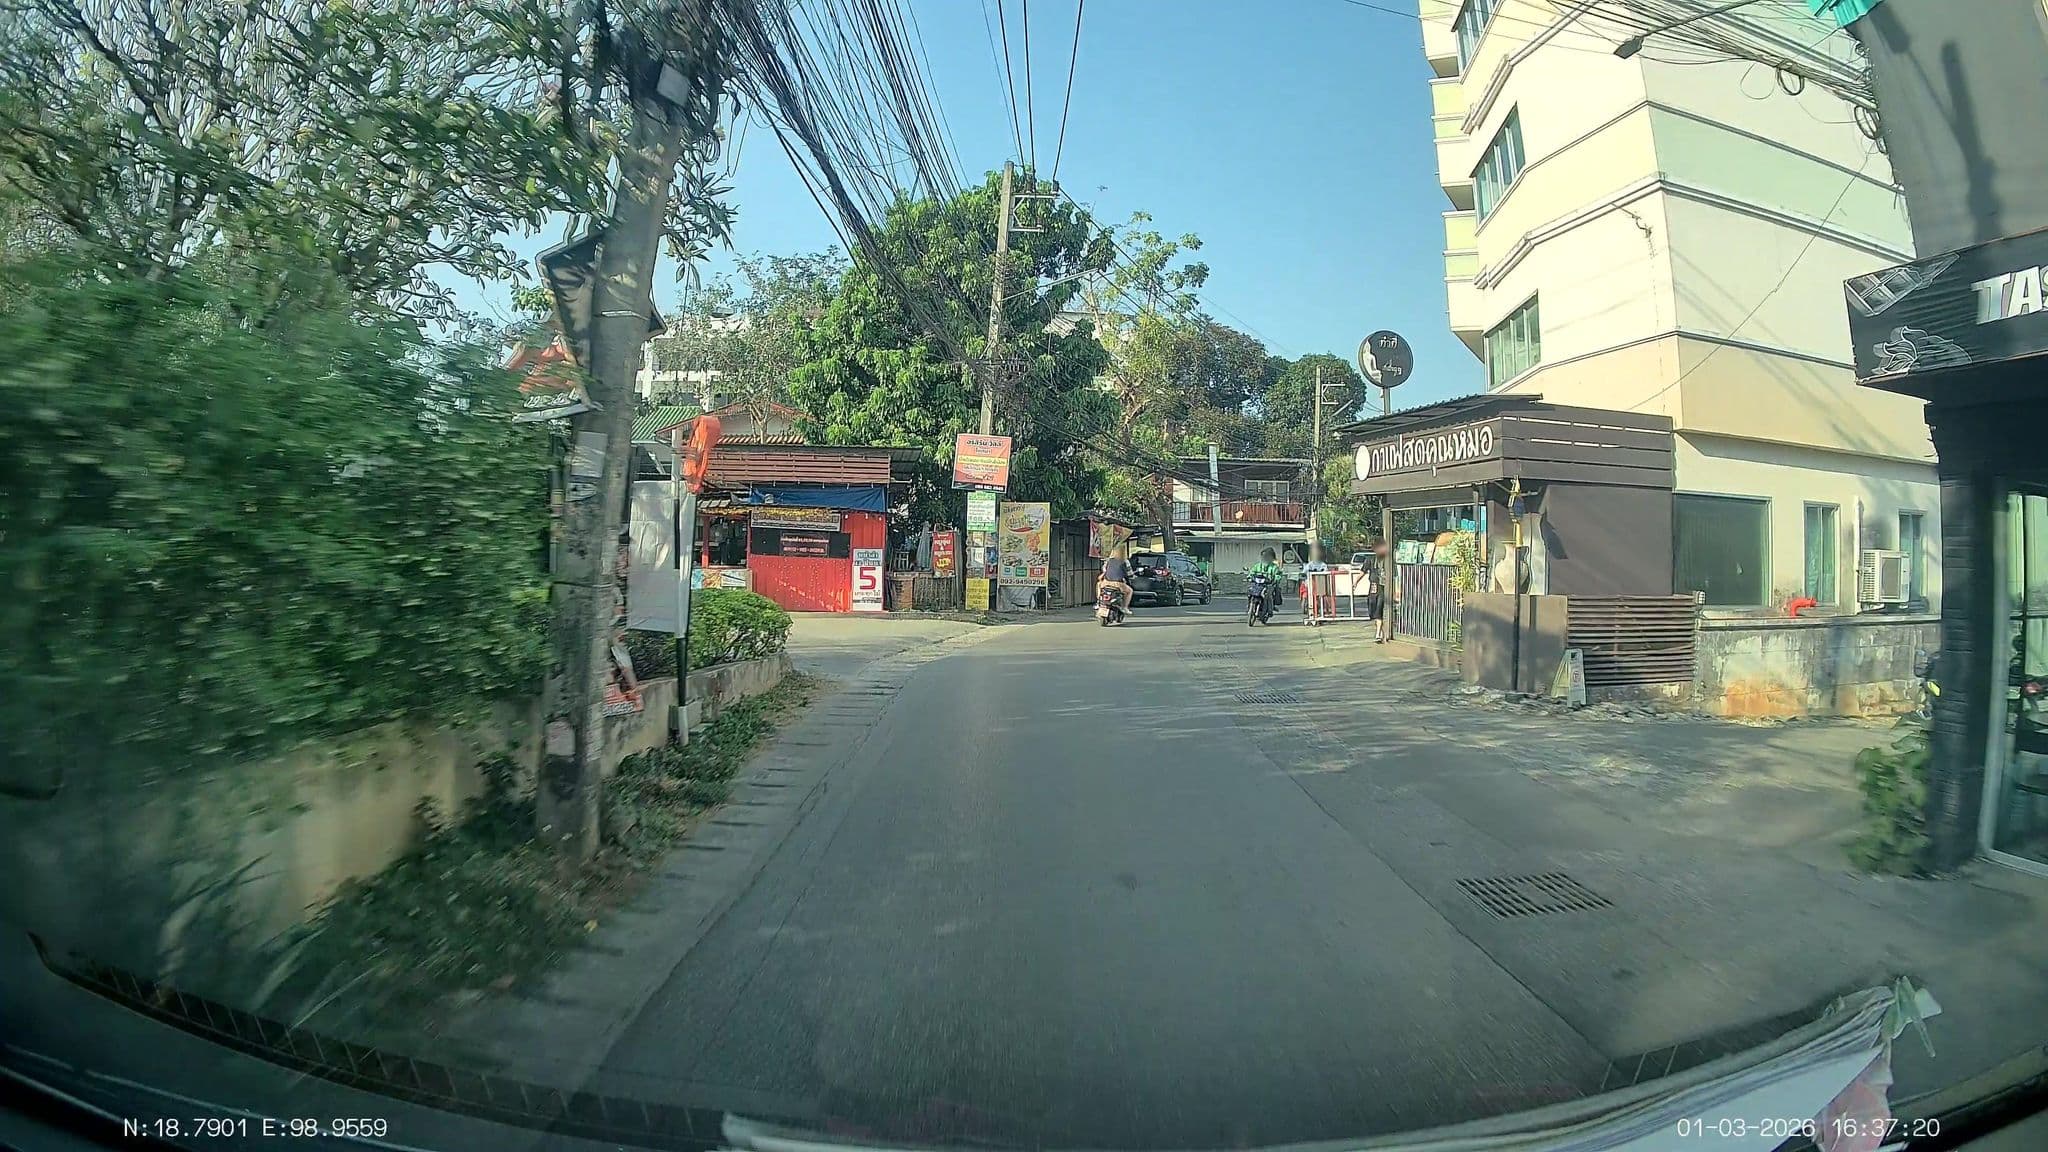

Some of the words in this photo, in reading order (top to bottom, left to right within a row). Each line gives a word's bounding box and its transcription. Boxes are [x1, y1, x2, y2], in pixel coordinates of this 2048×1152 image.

[1970, 264, 2048, 325] TA
[1372, 425, 1493, 477] กาแฟสดคุณหมอ
[860, 566, 876, 590] 5
